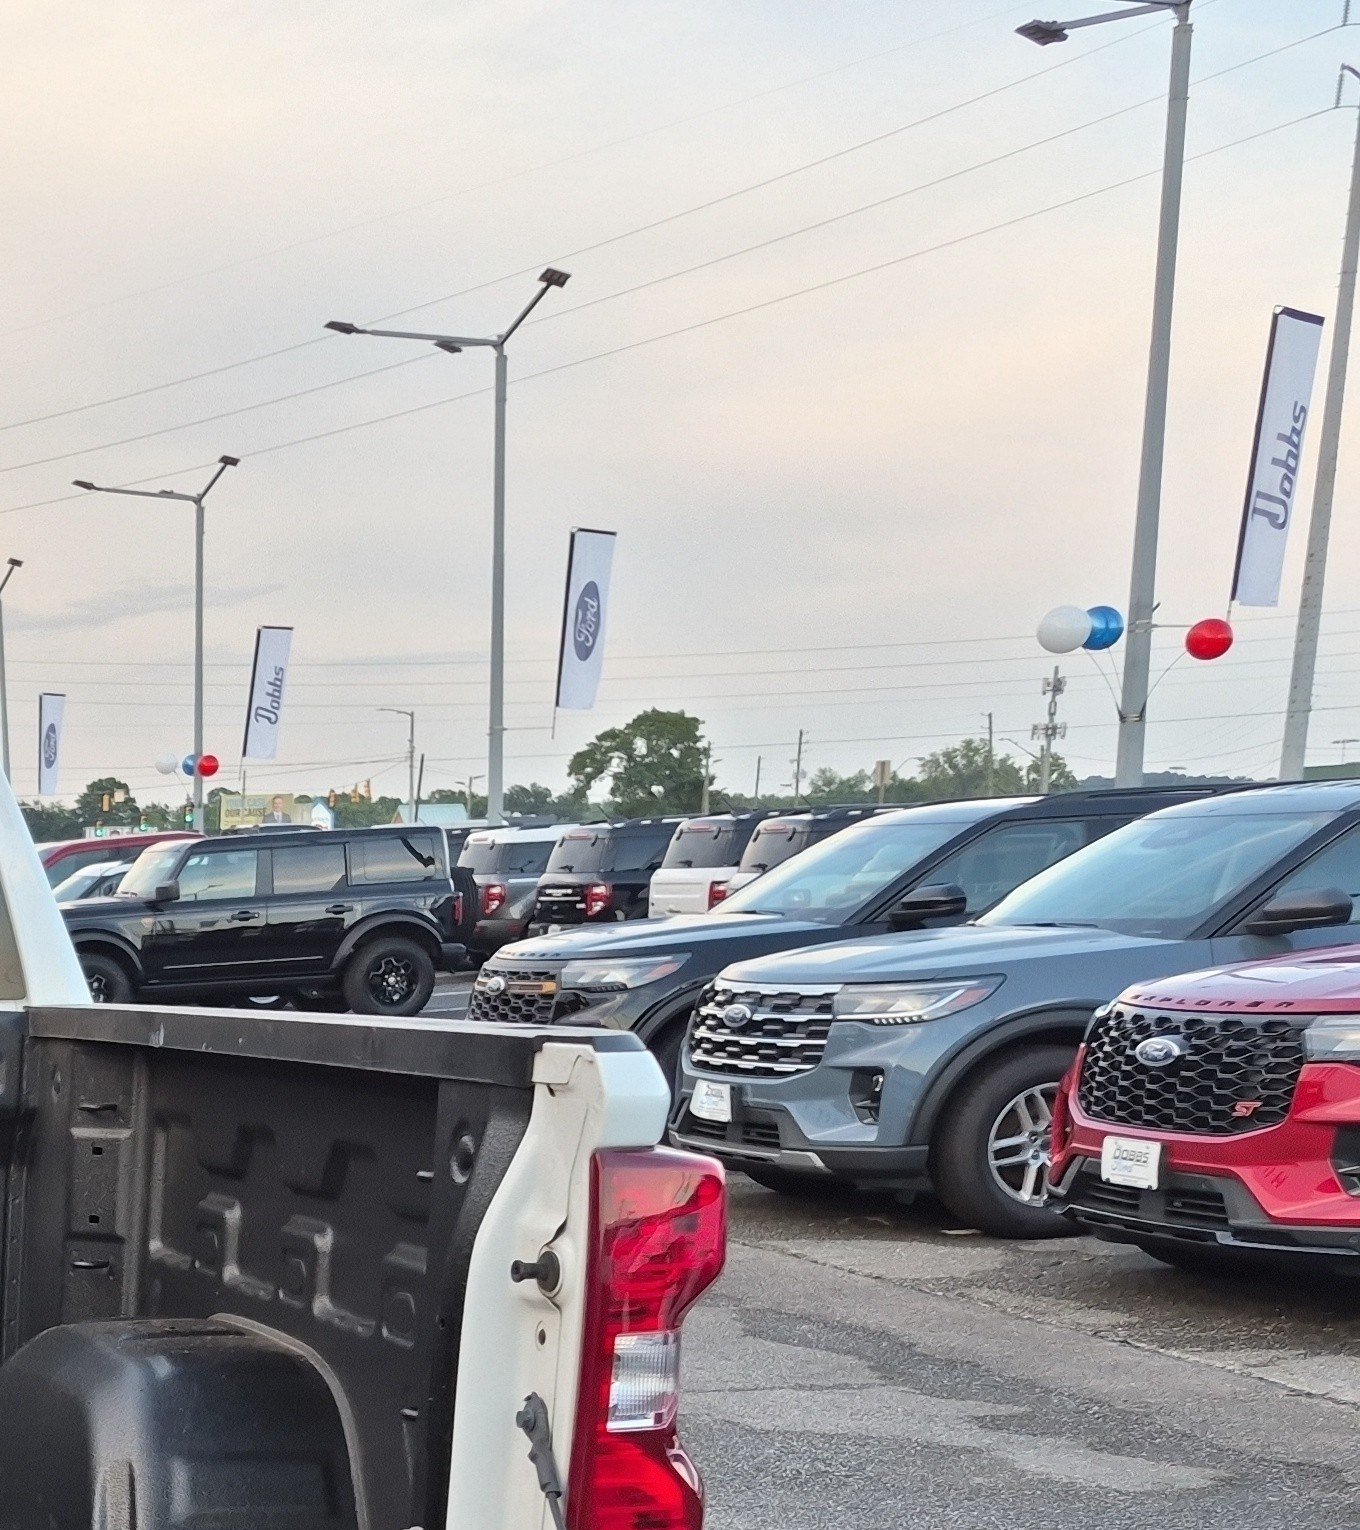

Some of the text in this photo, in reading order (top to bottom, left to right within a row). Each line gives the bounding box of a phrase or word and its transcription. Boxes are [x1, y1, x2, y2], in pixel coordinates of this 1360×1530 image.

[1251, 400, 1307, 531] Dobbs
[575, 596, 599, 648] Ford
[254, 665, 285, 725] Dobbs
[44, 731, 56, 762] Ford
[1130, 994, 1295, 1008] EXPLORER
[1231, 1101, 1264, 1118] ST
[1113, 1148, 1149, 1163] DOBBS
